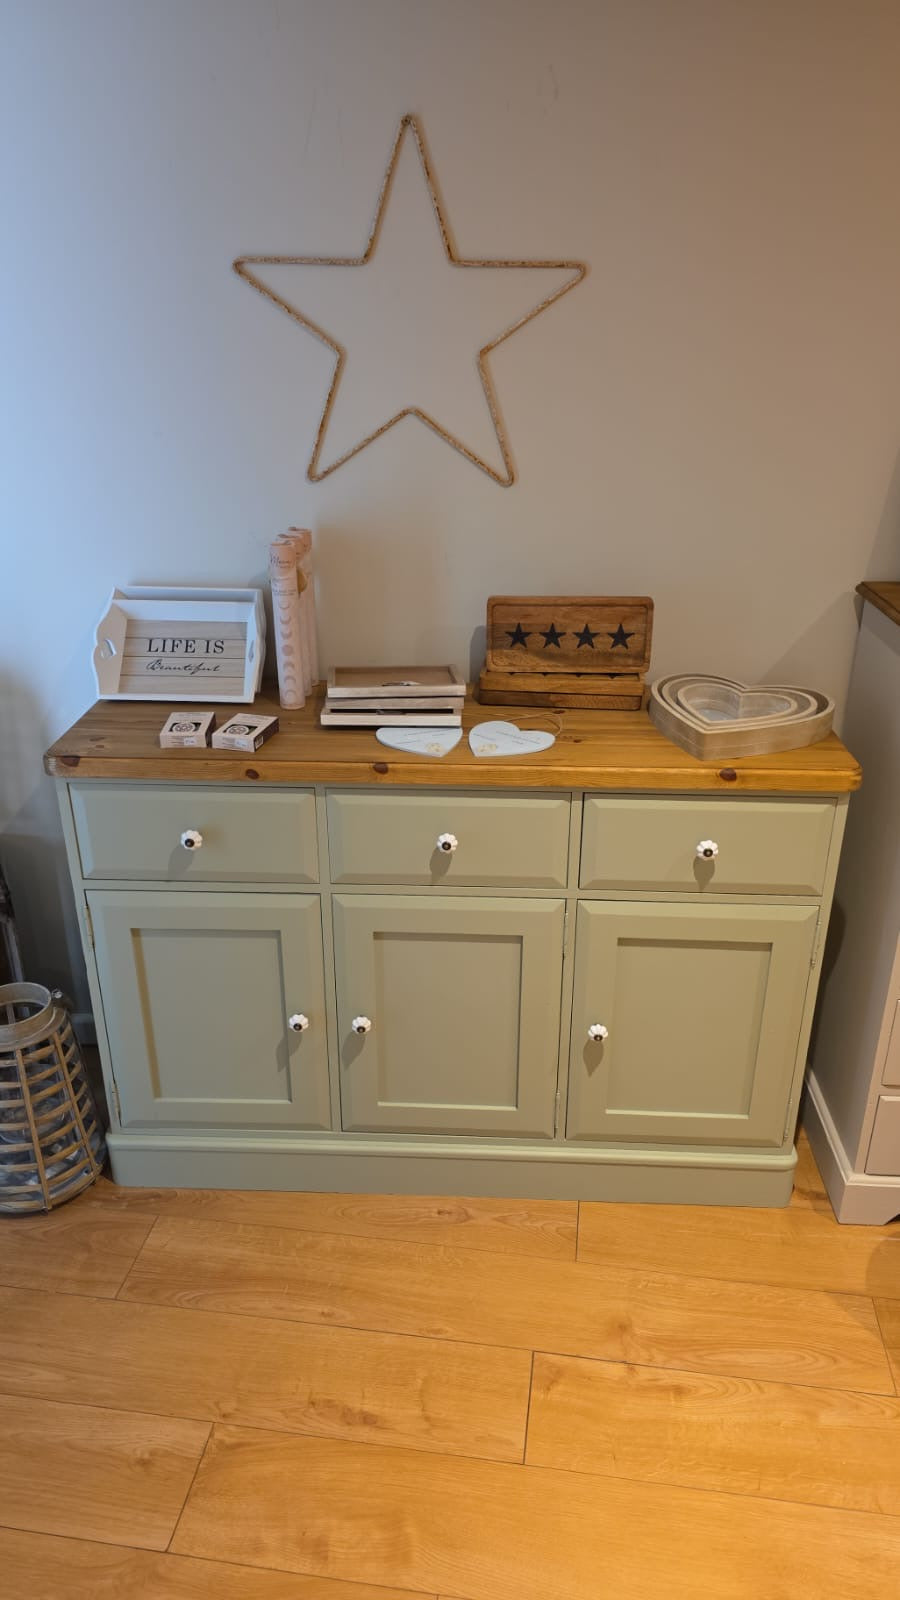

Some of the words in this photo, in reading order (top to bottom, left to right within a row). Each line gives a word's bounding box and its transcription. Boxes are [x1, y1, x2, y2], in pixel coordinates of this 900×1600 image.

[147, 638, 196, 653] LIFE
[205, 639, 225, 654] IS
[146, 659, 220, 675] Beautiful
